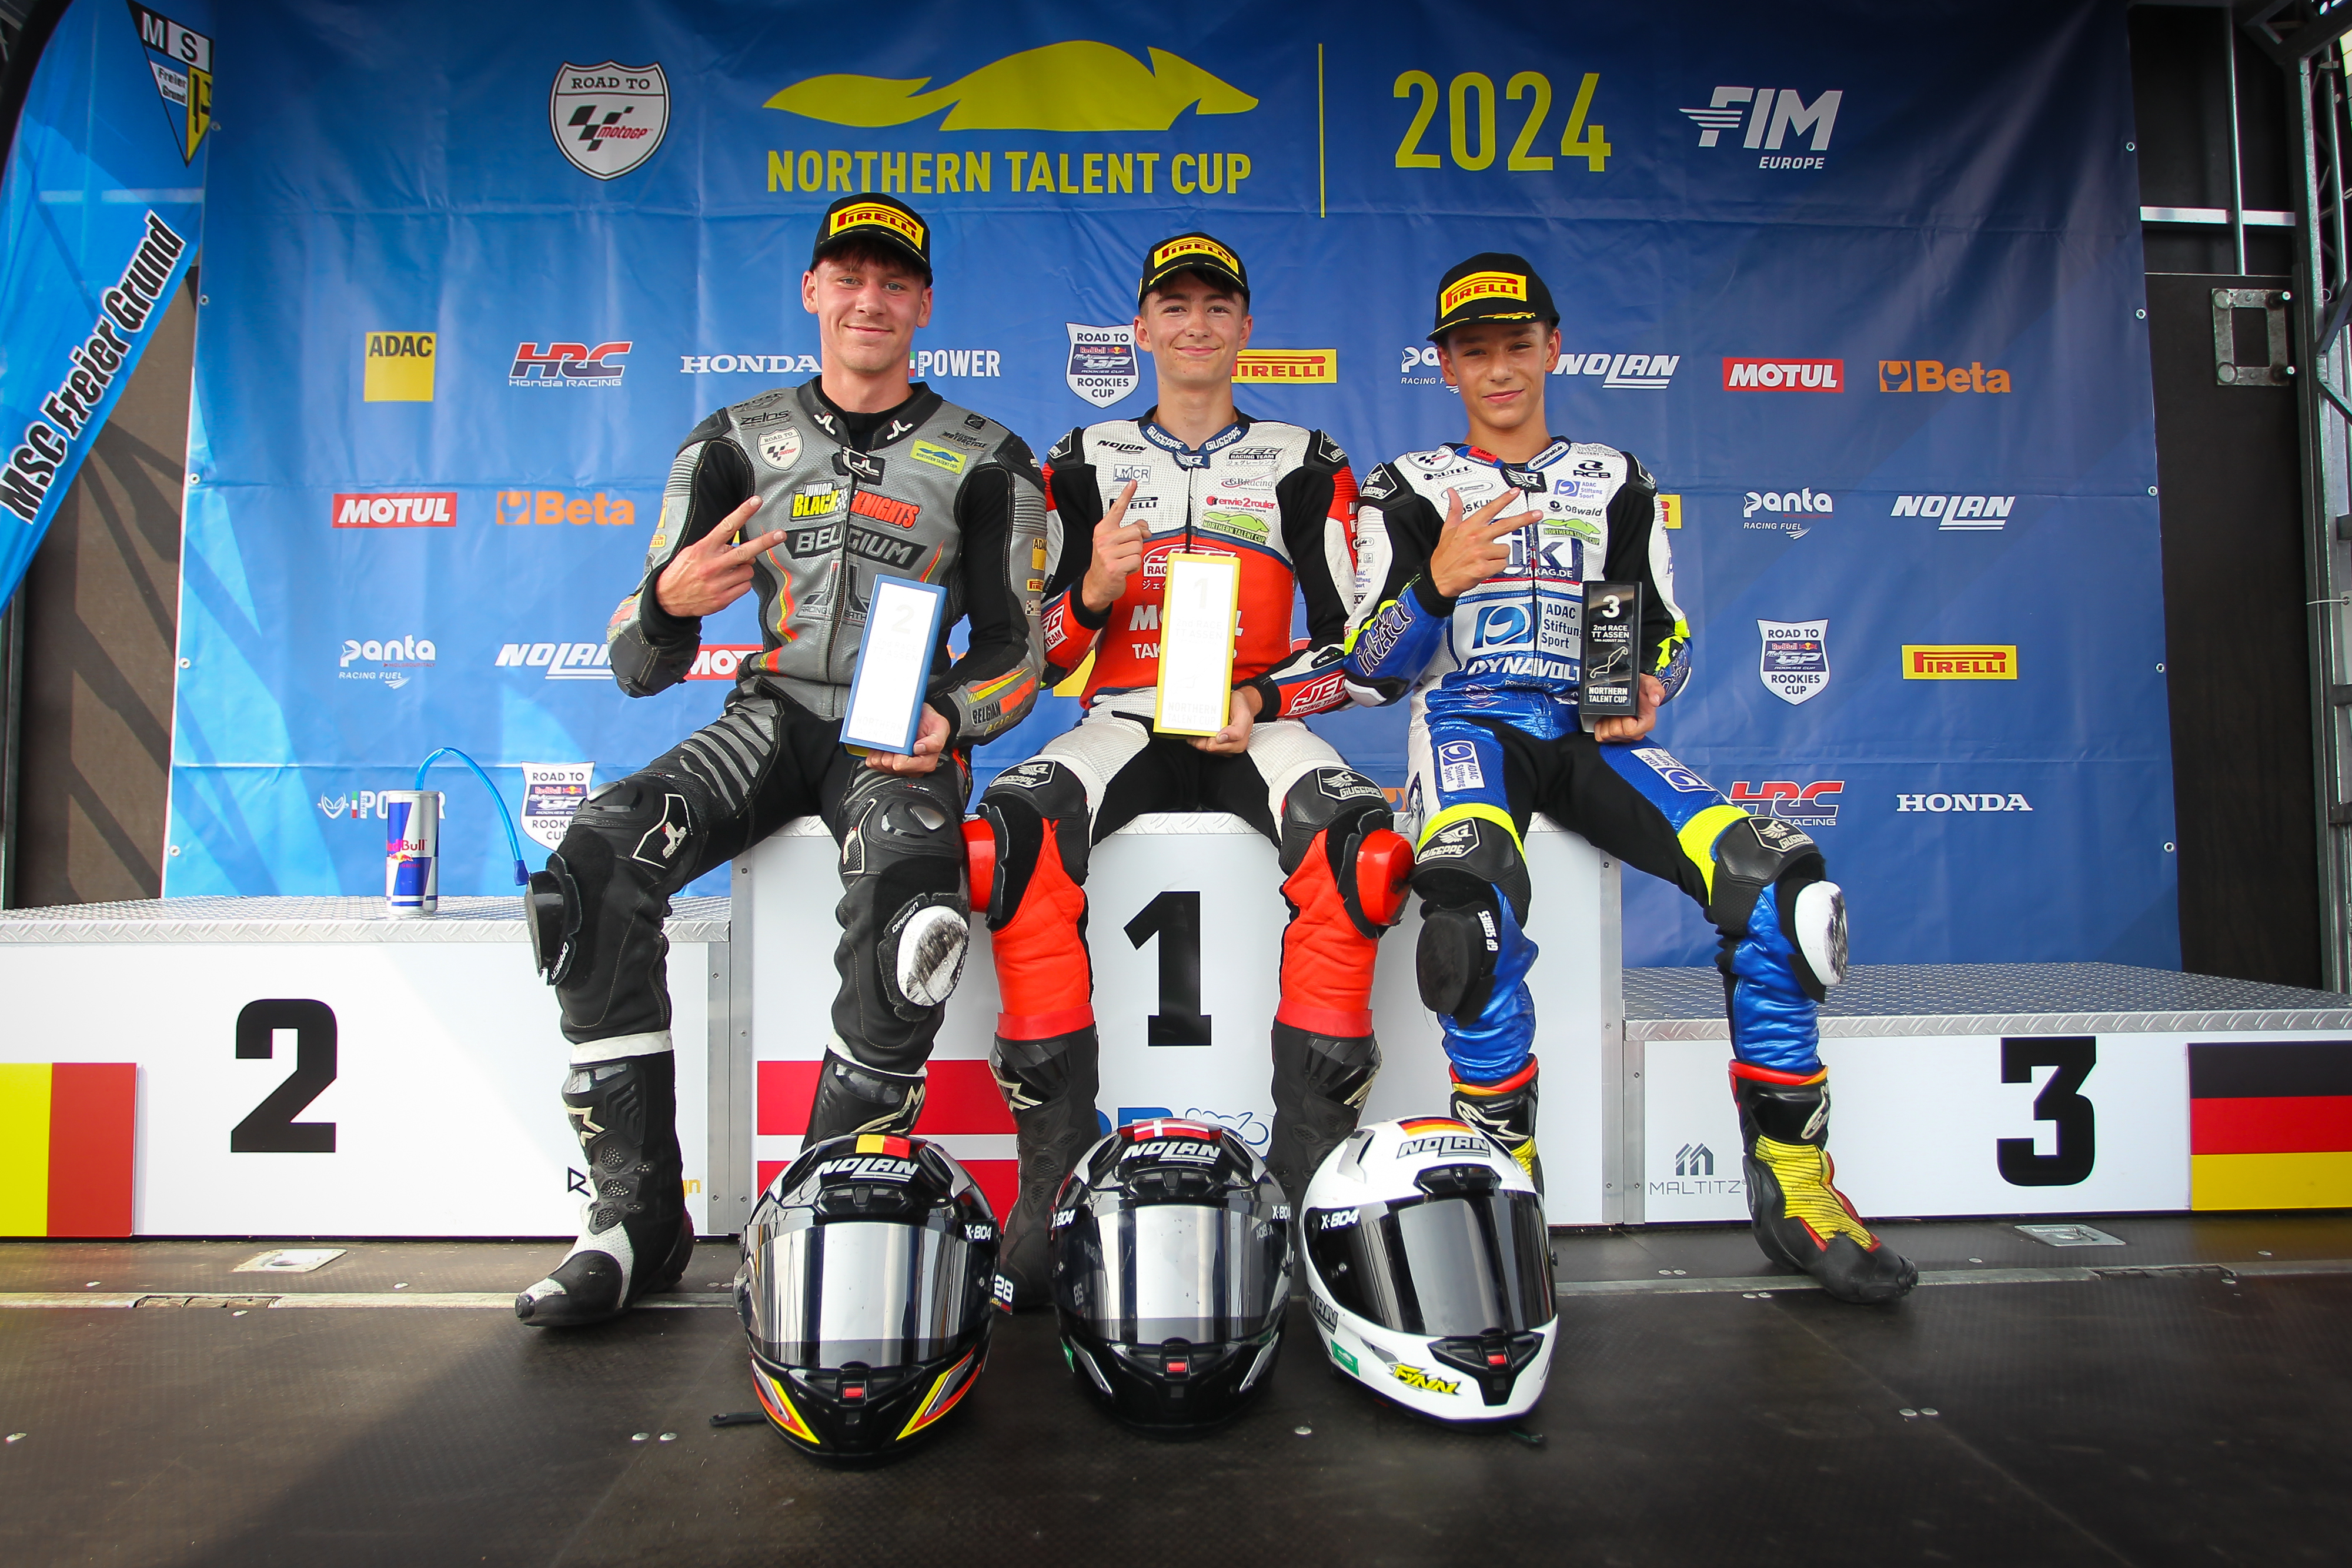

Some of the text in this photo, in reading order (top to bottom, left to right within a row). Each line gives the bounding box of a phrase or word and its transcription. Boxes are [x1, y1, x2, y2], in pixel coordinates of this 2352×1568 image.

[572, 77, 650, 89] ROAD TO
[1393, 70, 1611, 172] 2024
[1680, 86, 1843, 151] FIM
[768, 150, 1251, 193] NORTHERN TALENT CUP
[1759, 156, 1825, 169] EUROPE
[837, 206, 917, 239] PIRELLI
[1162, 240, 1231, 263] PIRELLI
[1446, 278, 1518, 309] PIRELLI
[369, 336, 432, 357] ADAC
[1077, 333, 1129, 342] ROAD TO
[0, 210, 186, 525] MSC Freier Grund
[509, 341, 632, 377] HRC
[680, 355, 822, 374] HONDA
[1401, 377, 1436, 385] RACING
[1552, 354, 1680, 389] NOLAN
[1729, 363, 1838, 387] MOTUL
[1916, 360, 2012, 393] Beta
[567, 379, 621, 387] RACING
[1077, 378, 1129, 387] ROOKIES
[1091, 389, 1114, 397] CUP
[941, 431, 987, 448] MOTORCYCLE
[1097, 440, 1148, 455] NOLAN
[1475, 448, 1492, 456] JRP
[1573, 470, 1611, 479] RCB
[805, 482, 833, 497] JUNIOR
[338, 498, 450, 523] MOTUL
[535, 492, 634, 525] Beta
[793, 489, 920, 528] BLACK KNIGHTS
[1743, 487, 1833, 518] panta
[1891, 496, 2015, 530] NOLAN
[1204, 520, 1266, 543] NORTHERN TALENT CUP
[795, 525, 913, 564] BELGIUM
[1194, 577, 1209, 610] 1
[1546, 603, 1576, 620] ADAC
[1602, 594, 1621, 618] 3
[891, 604, 915, 635] 2
[1045, 630, 1062, 647] TEAM
[1541, 633, 1570, 650] Sport
[1768, 628, 1819, 638] ROAD TO
[339, 634, 436, 667] panta
[1914, 652, 2006, 673] PIRELLI
[339, 671, 376, 680] RACING
[1771, 674, 1820, 684] ROOKIES
[1589, 687, 1628, 695] NORTHERN
[1589, 695, 1612, 703] TALENT
[1785, 686, 1807, 695] CUP
[973, 700, 1001, 724] BELGIAN
[1168, 702, 1217, 715] NORTHERN
[1291, 701, 1321, 714] RACING
[1642, 754, 1662, 767] ADAC
[533, 773, 584, 781] ROAD TO
[1444, 766, 1455, 783] Sport
[1454, 764, 1466, 788] Stiftung
[1467, 764, 1479, 780] ADAC
[1897, 794, 2033, 812] HONDA
[402, 839, 425, 851] Bull
[1477, 910, 1498, 951] GP SERIES
[1123, 891, 1212, 1047] 1
[230, 998, 338, 1153] 2
[1997, 1036, 2097, 1187] 3
[1120, 1142, 1221, 1165] NOLAN
[1396, 1136, 1490, 1158] NOLAN
[813, 1158, 918, 1182] NOLAN
[1650, 1180, 1740, 1195] MALTITZ
[994, 1274, 1014, 1303] 28
